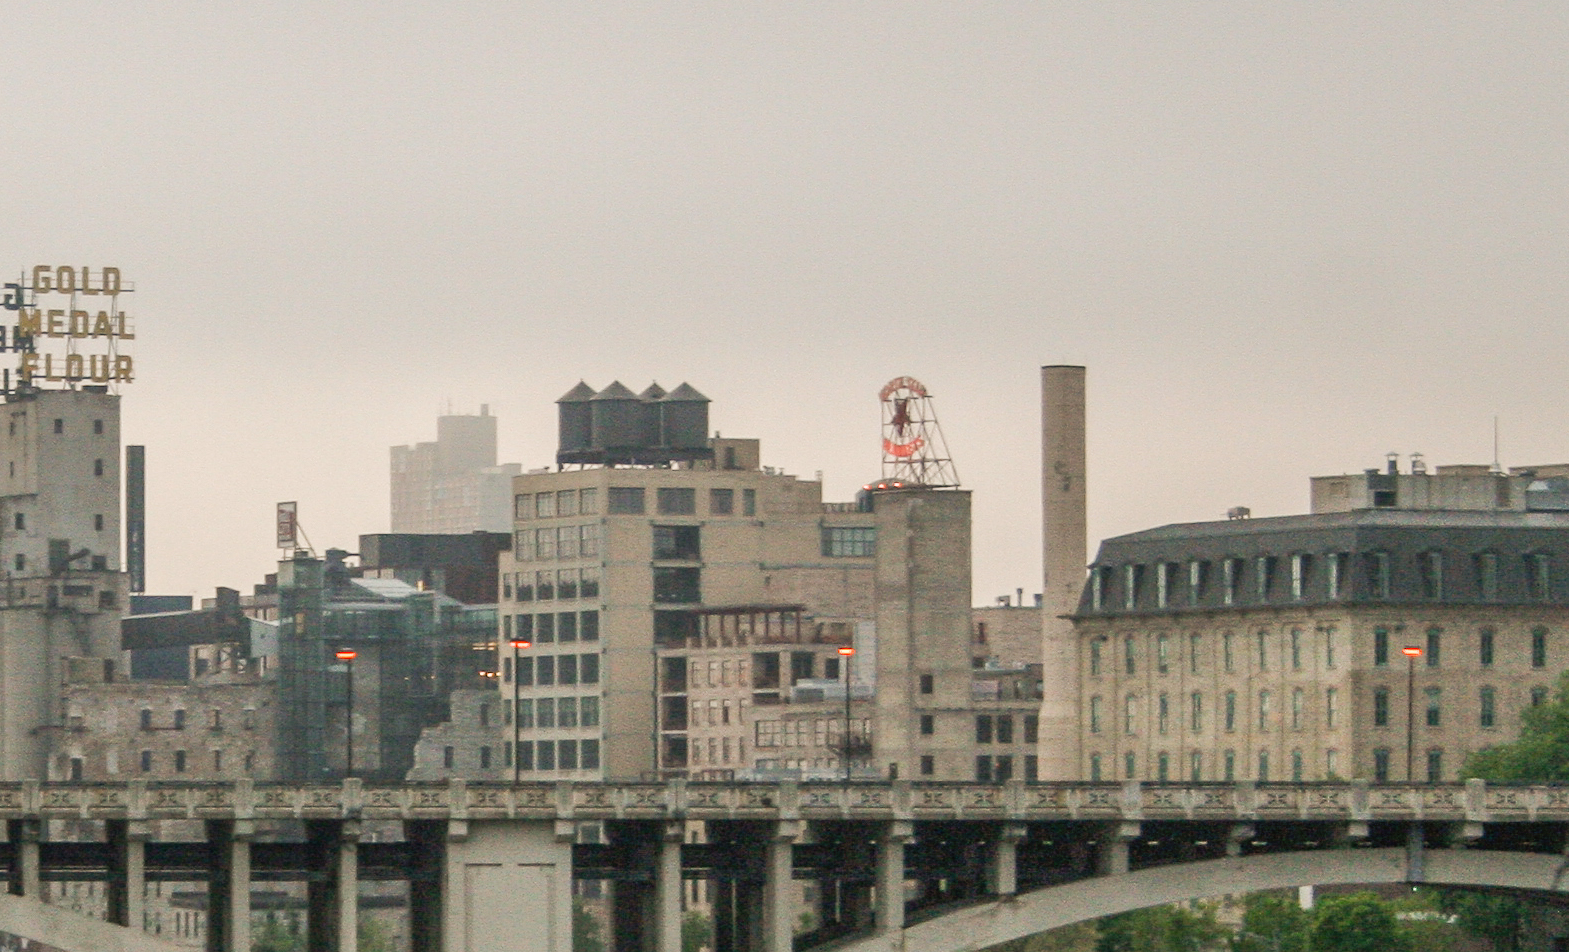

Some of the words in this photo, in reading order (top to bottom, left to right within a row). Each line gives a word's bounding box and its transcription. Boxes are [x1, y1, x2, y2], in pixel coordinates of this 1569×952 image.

[32, 265, 120, 295] GOLD
[19, 309, 135, 340] MEDAL
[22, 353, 133, 383] FLOUR
